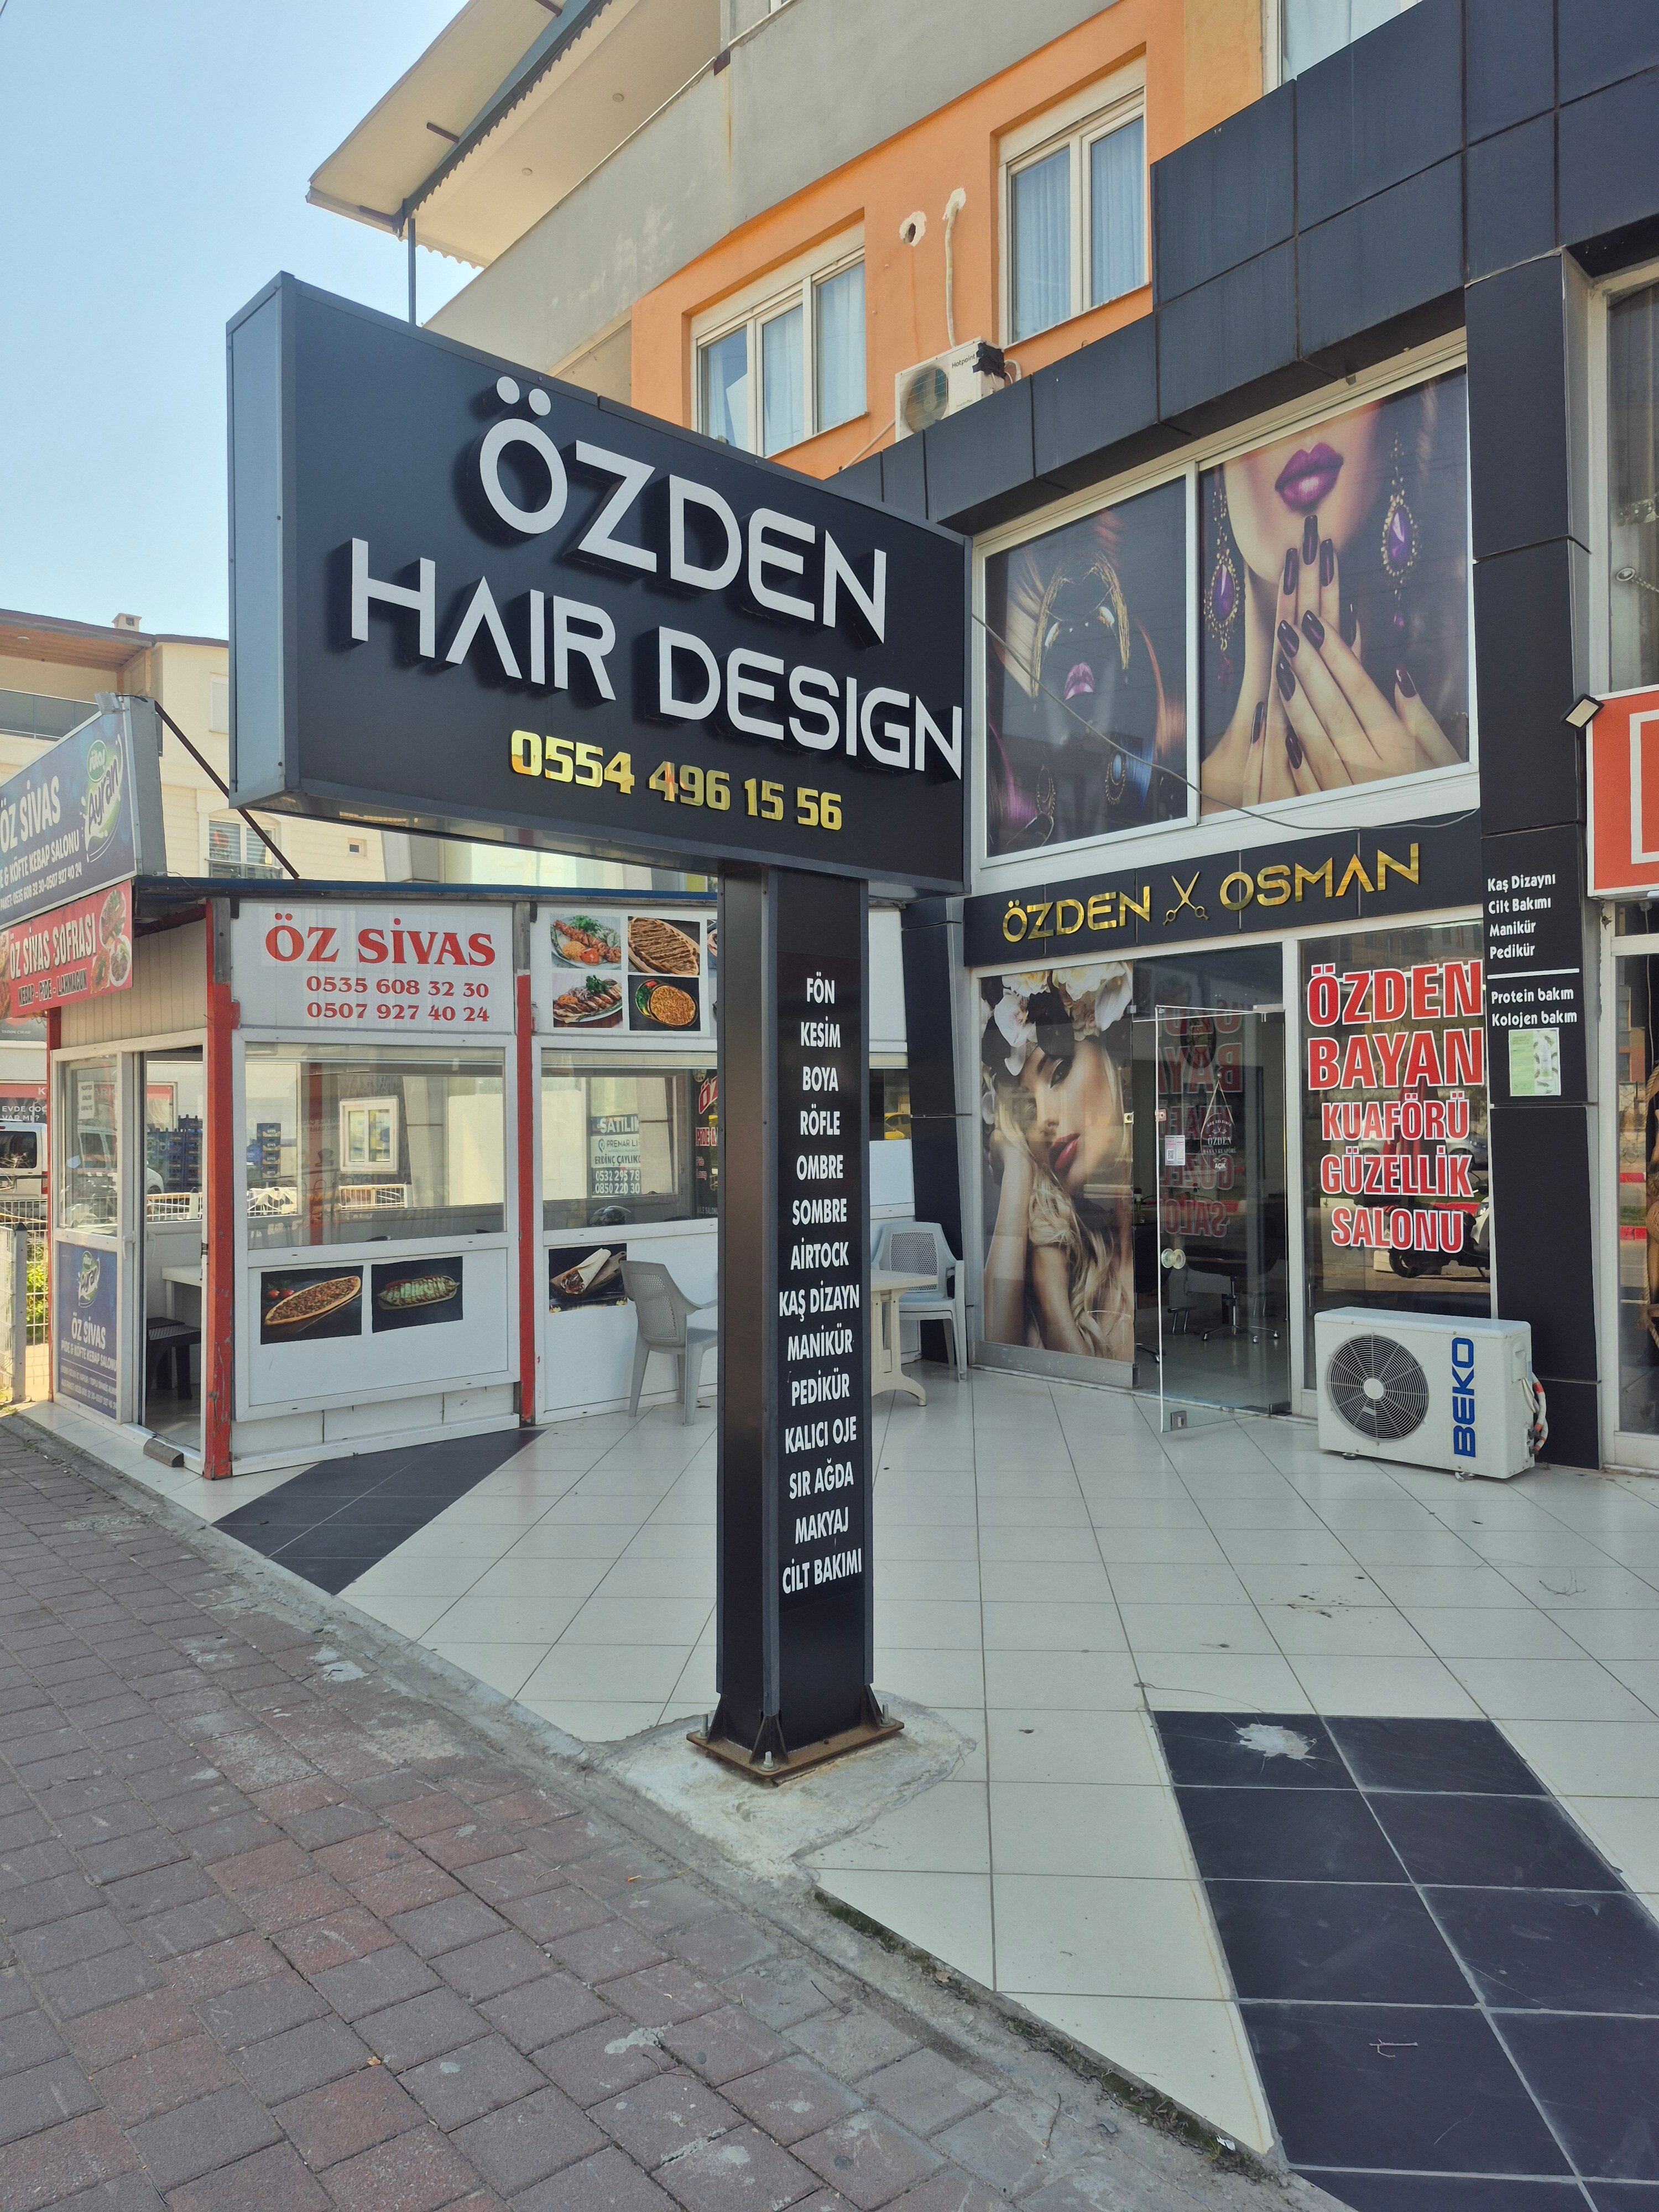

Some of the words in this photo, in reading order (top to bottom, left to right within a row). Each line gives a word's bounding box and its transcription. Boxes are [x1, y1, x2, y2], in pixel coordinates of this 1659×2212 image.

[952, 354, 975, 368] Hotpoint
[479, 377, 886, 644] ÖZDEN
[351, 538, 617, 701] HAIR
[659, 626, 963, 780] DESIGN
[88, 758, 118, 835] Ayran
[510, 730, 635, 794] 0554
[649, 761, 731, 811] 496
[744, 778, 784, 821] 15
[797, 787, 842, 830] 56
[0, 797, 18, 853] ÖZ
[20, 775, 60, 842] SİVAS
[4, 865, 9, 883] &
[10, 857, 28, 884] KÖFTE
[29, 844, 49, 873] KEBAP
[51, 829, 79, 863] SALONU
[23, 883, 32, 900] 608
[32, 881, 38, 896] 32
[58, 869, 67, 886] 927
[75, 862, 82, 878] 24
[1003, 886, 1150, 942] ÖZDEN
[1219, 843, 1420, 911] OSMAN
[1488, 877, 1509, 893] Kaş
[1511, 873, 1556, 890] Dizaynı
[1488, 899, 1509, 915] Cilt
[1512, 896, 1551, 912] Bakımı
[10, 933, 21, 979] ÖZ
[23, 927, 50, 976] SİVAS
[52, 912, 96, 967] SOFRASI
[265, 912, 340, 963] ÖZ
[357, 917, 496, 967] SİVAS
[1489, 921, 1536, 937] Manikür
[1490, 943, 1535, 960] Pedikür
[18, 983, 34, 1007] KEBAP
[39, 978, 52, 1002] PİDE
[57, 968, 87, 997] LAHMACUN
[306, 975, 368, 994] 0535
[376, 979, 420, 996] 608
[427, 980, 455, 997] 32
[463, 983, 489, 998] 30
[806, 971, 835, 1004] FÖN
[1307, 959, 1484, 1027] ÖZDEN
[1491, 989, 1535, 1005] Protein
[1538, 987, 1574, 1001] bakım
[307, 1001, 368, 1019] 0507
[377, 1004, 420, 1020] 927
[427, 1004, 456, 1022] 40
[463, 1006, 489, 1022] 24
[1492, 1011, 1537, 1029] Kolojen
[1541, 1010, 1577, 1024] bakım
[801, 1015, 841, 1048] KESİM
[1308, 1027, 1485, 1091] BAYAN
[802, 1066, 839, 1092] BOYA
[800, 1103, 840, 1136] RÖFLE
[1322, 1092, 1470, 1140] KUAFÖRÜ
[696, 1128, 709, 1146] PİDE
[1207, 1134, 1232, 1146] ÖZDEN
[594, 1154, 615, 1166] ERDİNÇ
[596, 1171, 613, 1181] 0532
[614, 1170, 628, 1181] 295
[630, 1170, 640, 1181] 78
[796, 1154, 844, 1180] OMBRE
[1321, 1145, 1475, 1197] GÜZELLİK
[595, 1183, 613, 1194] 0850
[614, 1183, 628, 1194] 220
[630, 1182, 640, 1194] 30
[792, 1198, 847, 1225] SOMBRE
[1331, 1207, 1464, 1253] SALONU
[790, 1237, 849, 1270] AİRTOCK
[779, 1289, 806, 1322] KAŞ
[810, 1280, 860, 1314] DİZAYN
[71, 1312, 82, 1341] ÖZ
[84, 1316, 106, 1350] SİVAS
[787, 1323, 853, 1361] MANİKÜR
[791, 1368, 850, 1406] PEDİKÜR
[1451, 1337, 1476, 1458] BEKO
[785, 1421, 828, 1454] KALICI
[832, 1416, 857, 1443] OJE
[789, 1470, 810, 1499] SIR
[814, 1458, 854, 1494] AĞDA
[795, 1506, 849, 1544] MAKYAJ
[782, 1558, 810, 1594] CİLT
[814, 1548, 862, 1585] BAKIMI
